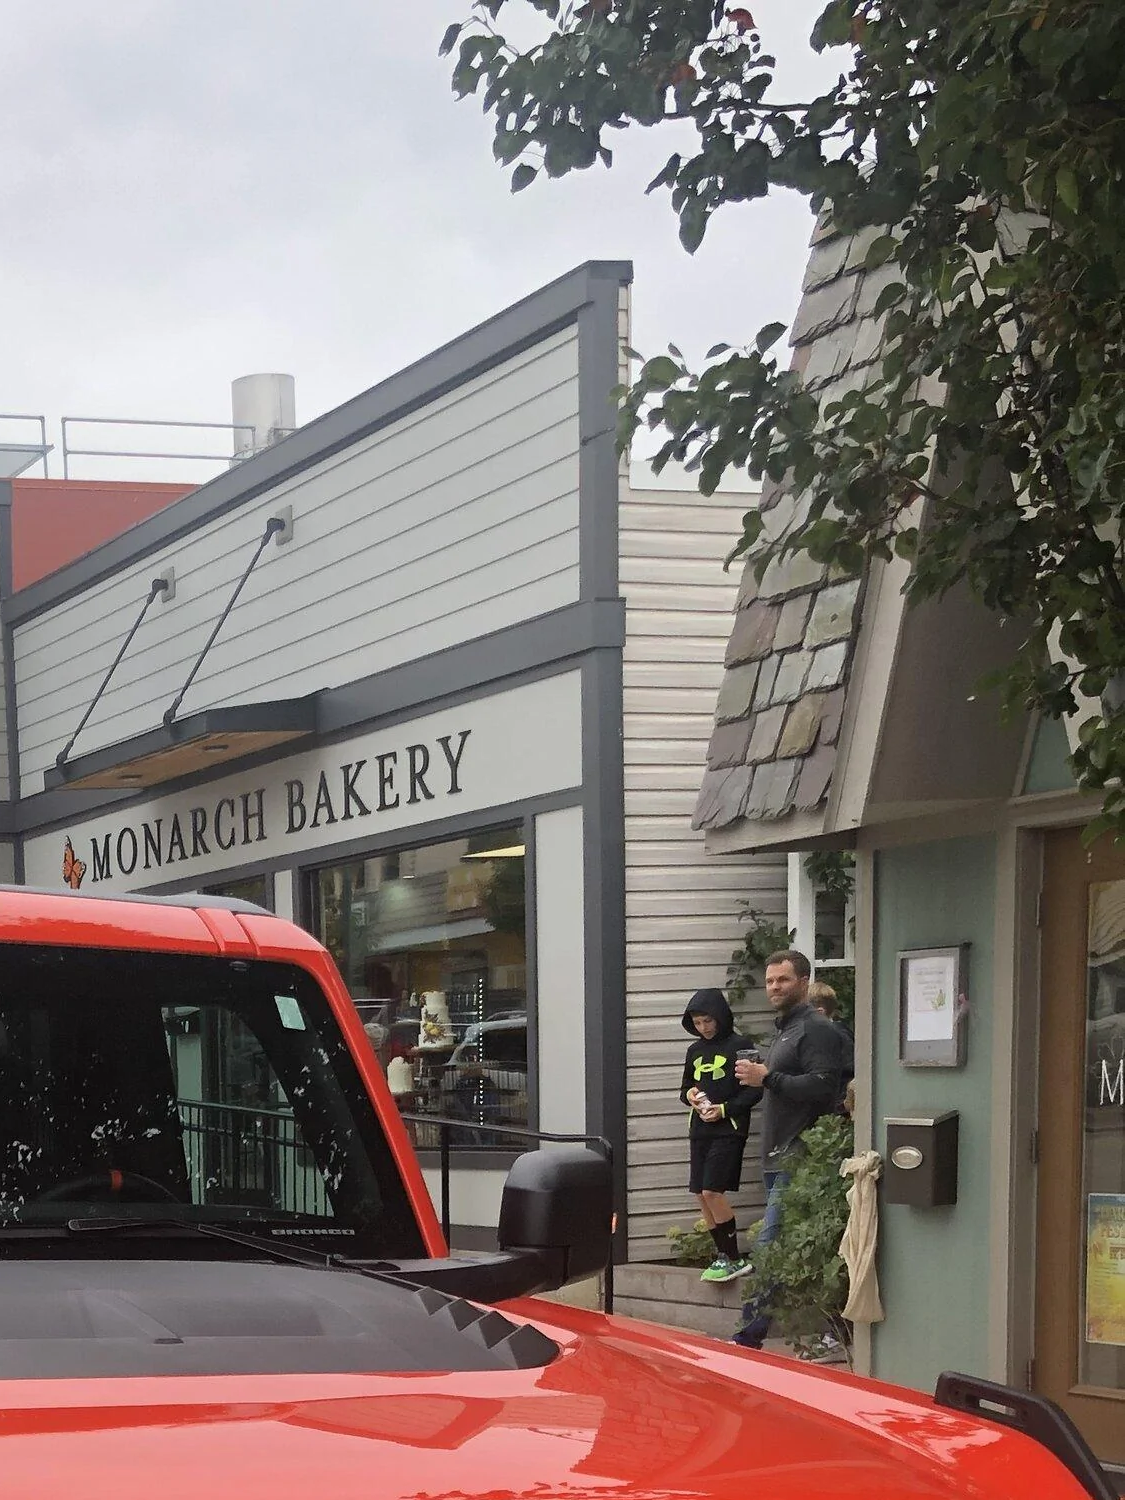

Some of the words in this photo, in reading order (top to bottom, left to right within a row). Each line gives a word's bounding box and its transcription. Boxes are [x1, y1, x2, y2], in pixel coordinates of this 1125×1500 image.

[91, 788, 268, 884] MONARCH
[284, 729, 472, 835] BAKERY
[271, 1228, 355, 1236] BRONCO
